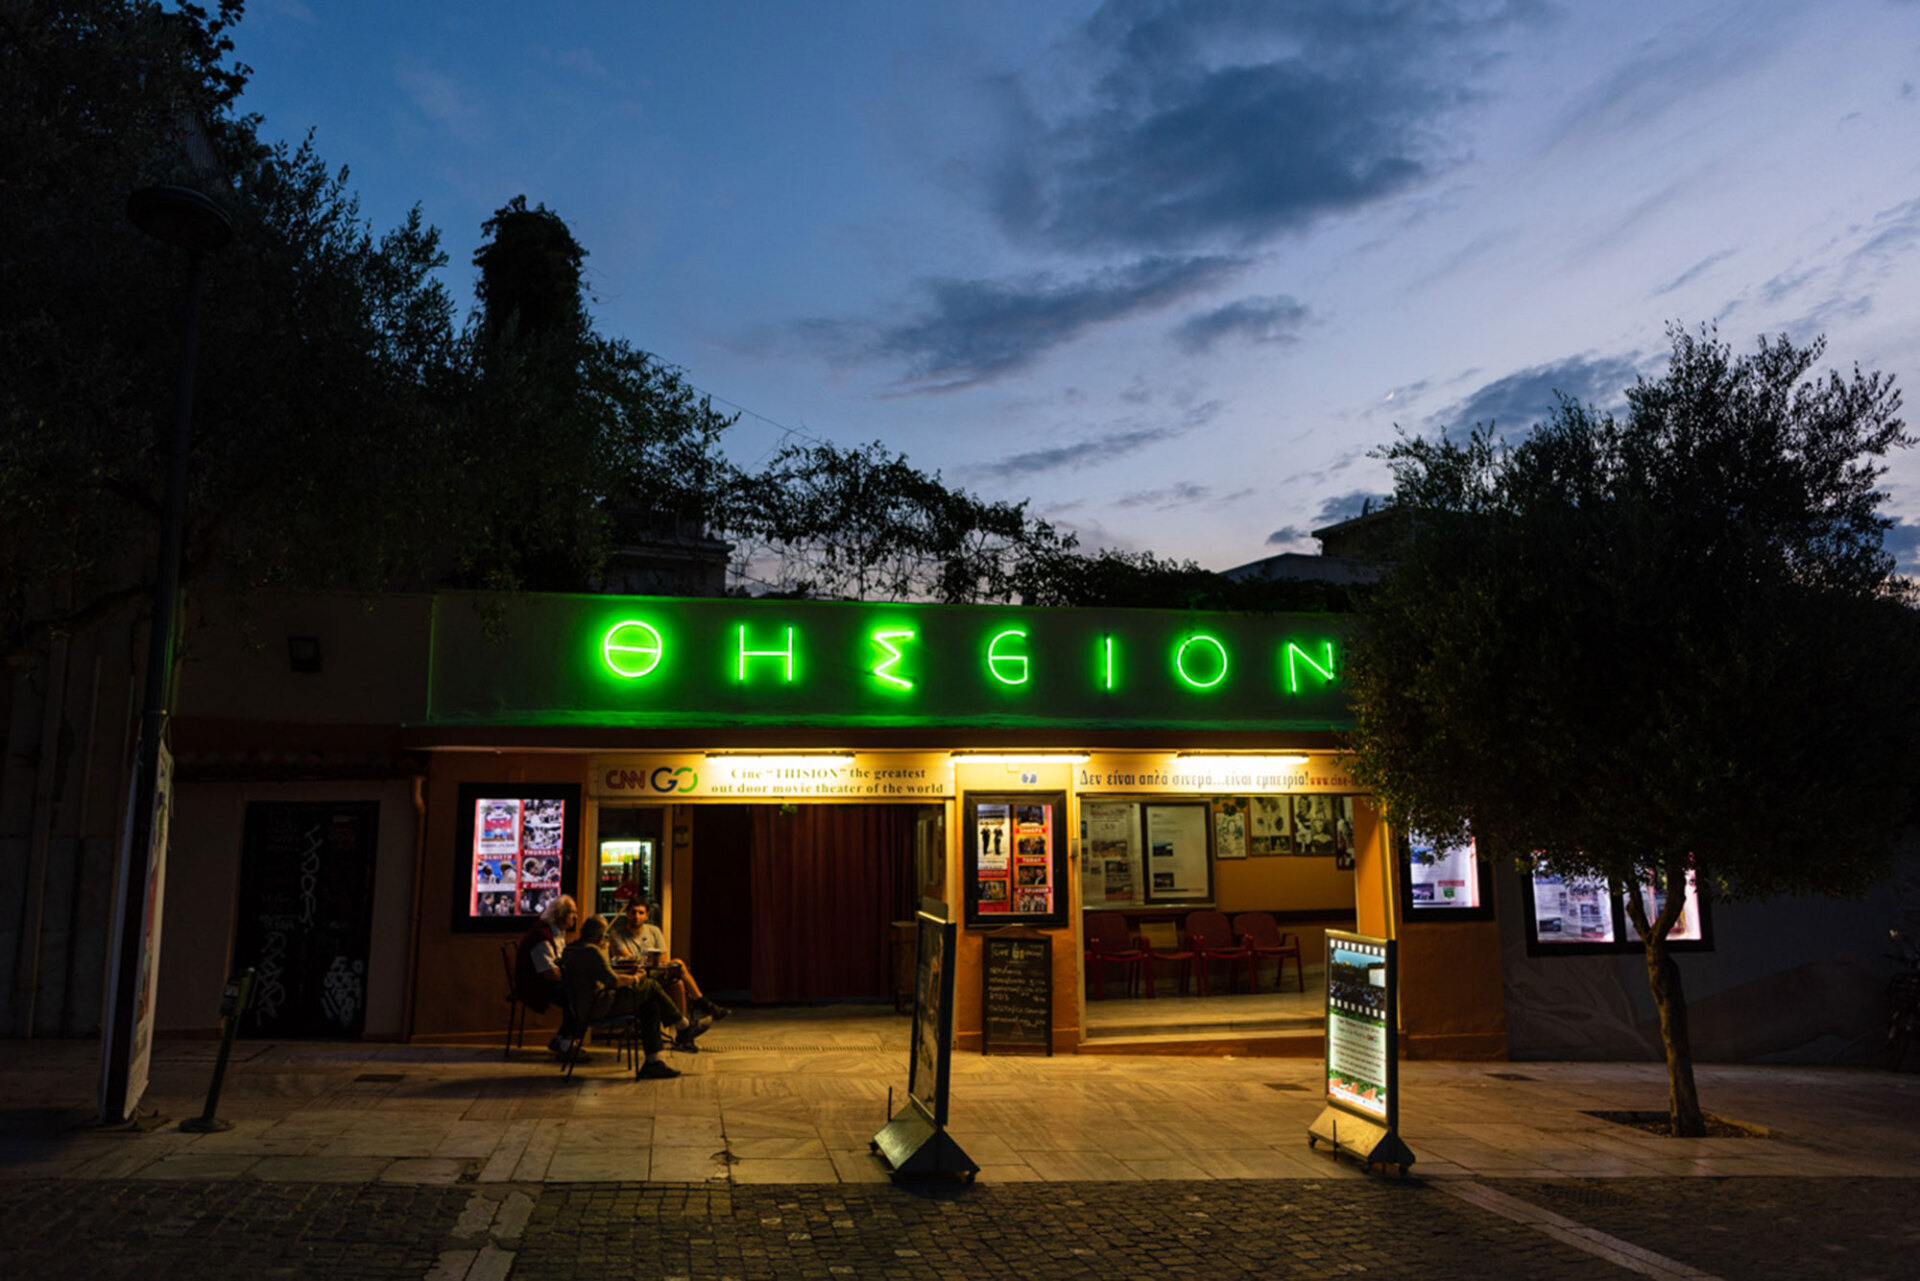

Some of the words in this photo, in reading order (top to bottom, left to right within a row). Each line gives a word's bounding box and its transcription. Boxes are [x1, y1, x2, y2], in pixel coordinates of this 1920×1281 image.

[605, 769, 645, 789] CNN
[651, 766, 698, 793] GO
[731, 767, 762, 780] Cine
[849, 767, 870, 780] the
[874, 767, 926, 782] greatest
[1080, 769, 1102, 786] Δεν
[1107, 769, 1135, 786] είναι
[711, 784, 733, 794] out
[737, 783, 768, 794] door
[773, 783, 811, 794] movie
[816, 783, 862, 794] theater
[866, 782, 880, 794] of
[884, 782, 902, 794] the
[906, 782, 944, 794] world
